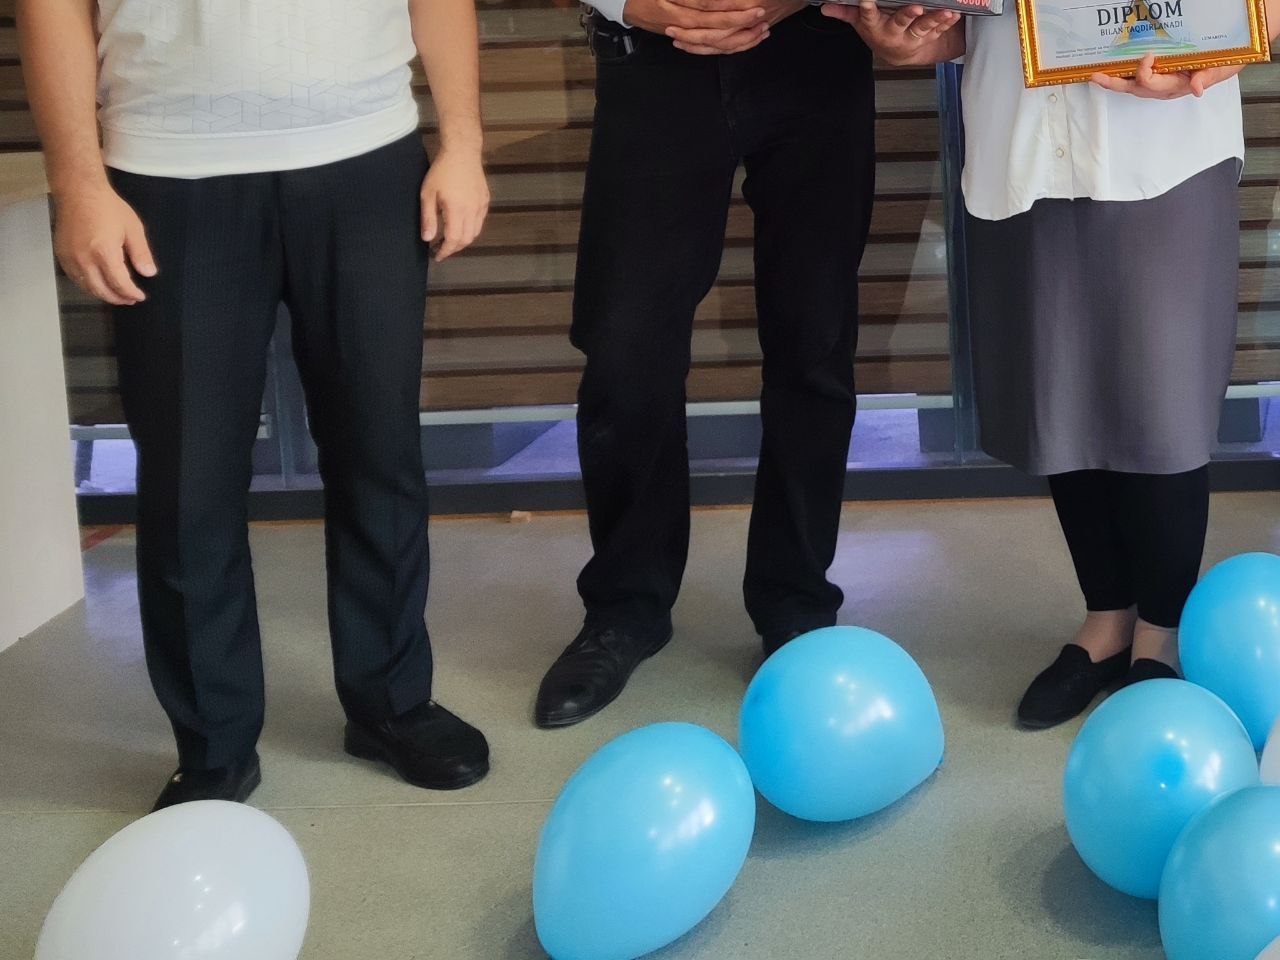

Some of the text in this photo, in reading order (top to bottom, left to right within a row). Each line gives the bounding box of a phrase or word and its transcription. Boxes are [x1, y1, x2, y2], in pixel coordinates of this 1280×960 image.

[1096, 0, 1183, 27] DIPLOM
[1100, 20, 1183, 37] BILAN TAQDIRLANADI
